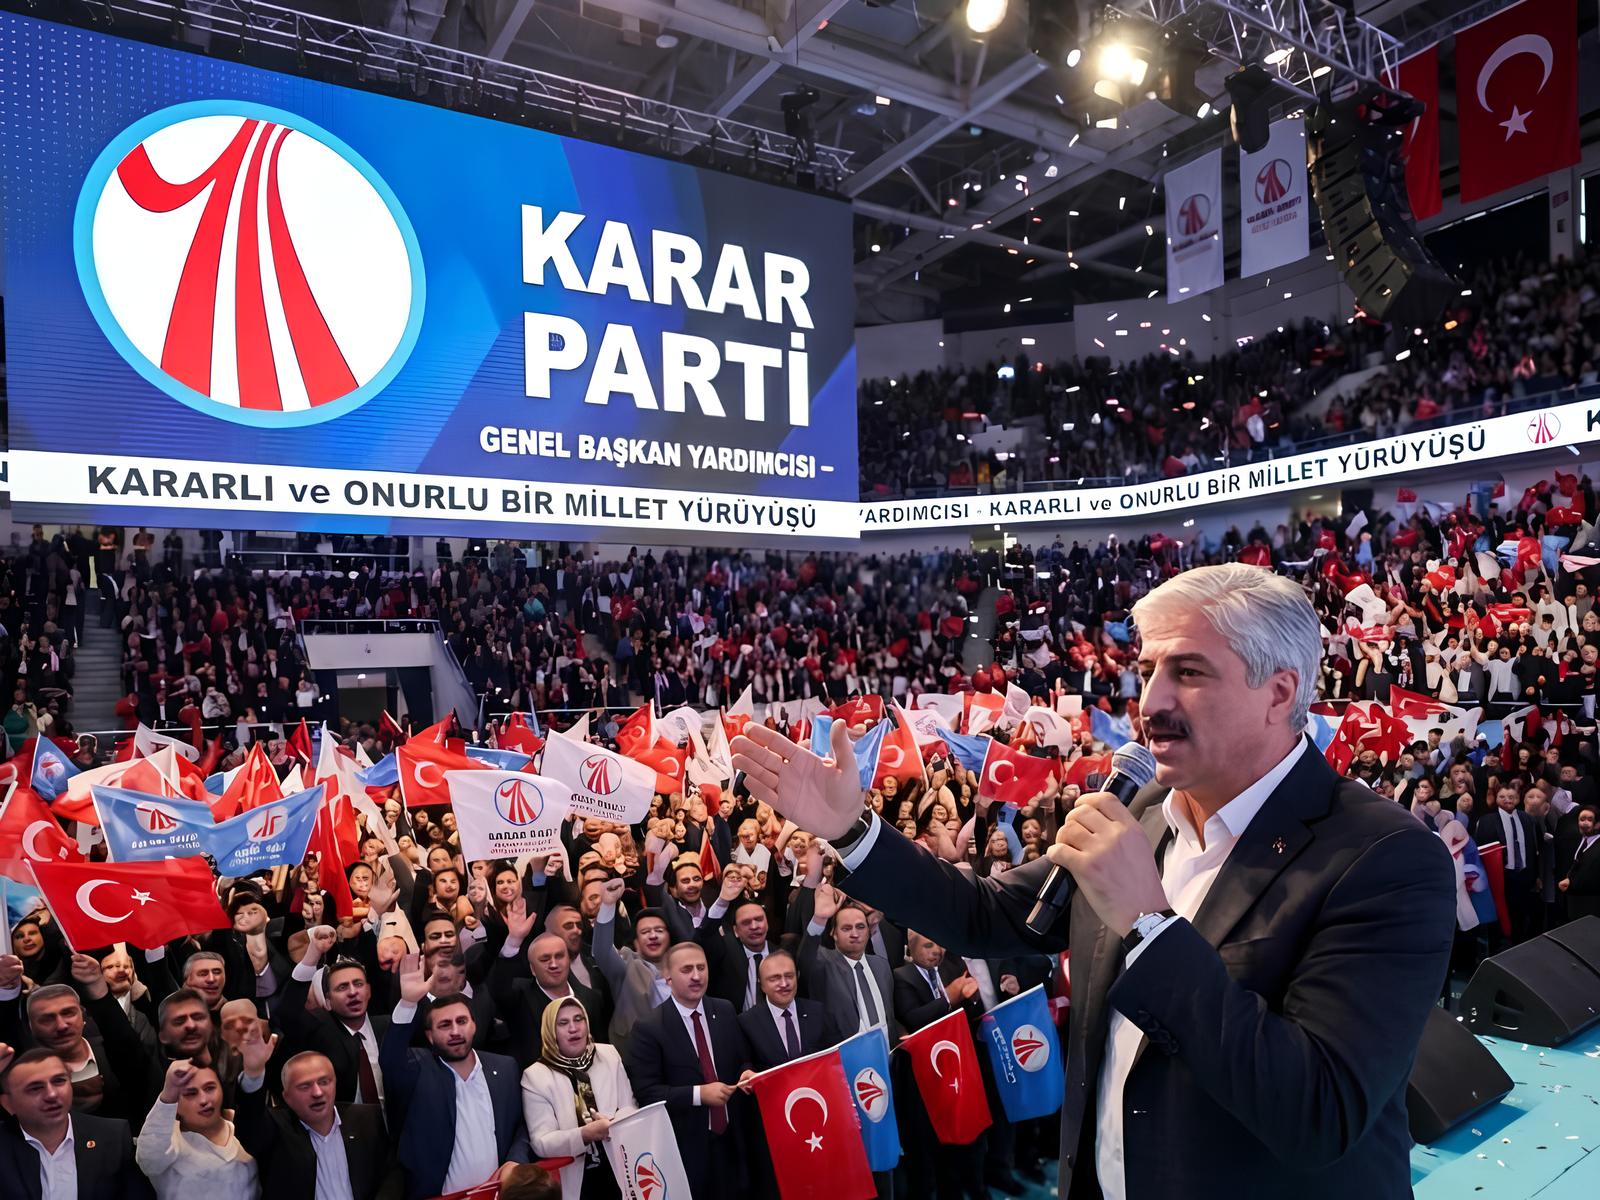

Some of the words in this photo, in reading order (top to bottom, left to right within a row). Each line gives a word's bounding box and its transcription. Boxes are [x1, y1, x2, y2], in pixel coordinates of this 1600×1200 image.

[521, 203, 815, 329] KARAR
[524, 311, 810, 427] PARTİ
[88, 465, 273, 501] KARARLI
[288, 483, 330, 504] ve
[343, 480, 488, 511] ONURLU
[502, 484, 554, 514] BİR
[565, 489, 668, 520] MİLLET
[678, 497, 816, 532] YÜRÜYÜŞÜ
[479, 425, 571, 458] GENEL
[578, 434, 681, 468] BAŞKAN
[686, 444, 816, 479] YARDIMCISI
[859, 503, 969, 523] ARDIMCISI
[990, 496, 1081, 516] KARARLI
[1089, 499, 1112, 510] ve
[1120, 481, 1199, 509] ONURLU
[1208, 474, 1240, 495] BİR
[1249, 458, 1328, 489] MİLLET
[1338, 425, 1486, 473] YÜRÜYÜŞÜ
